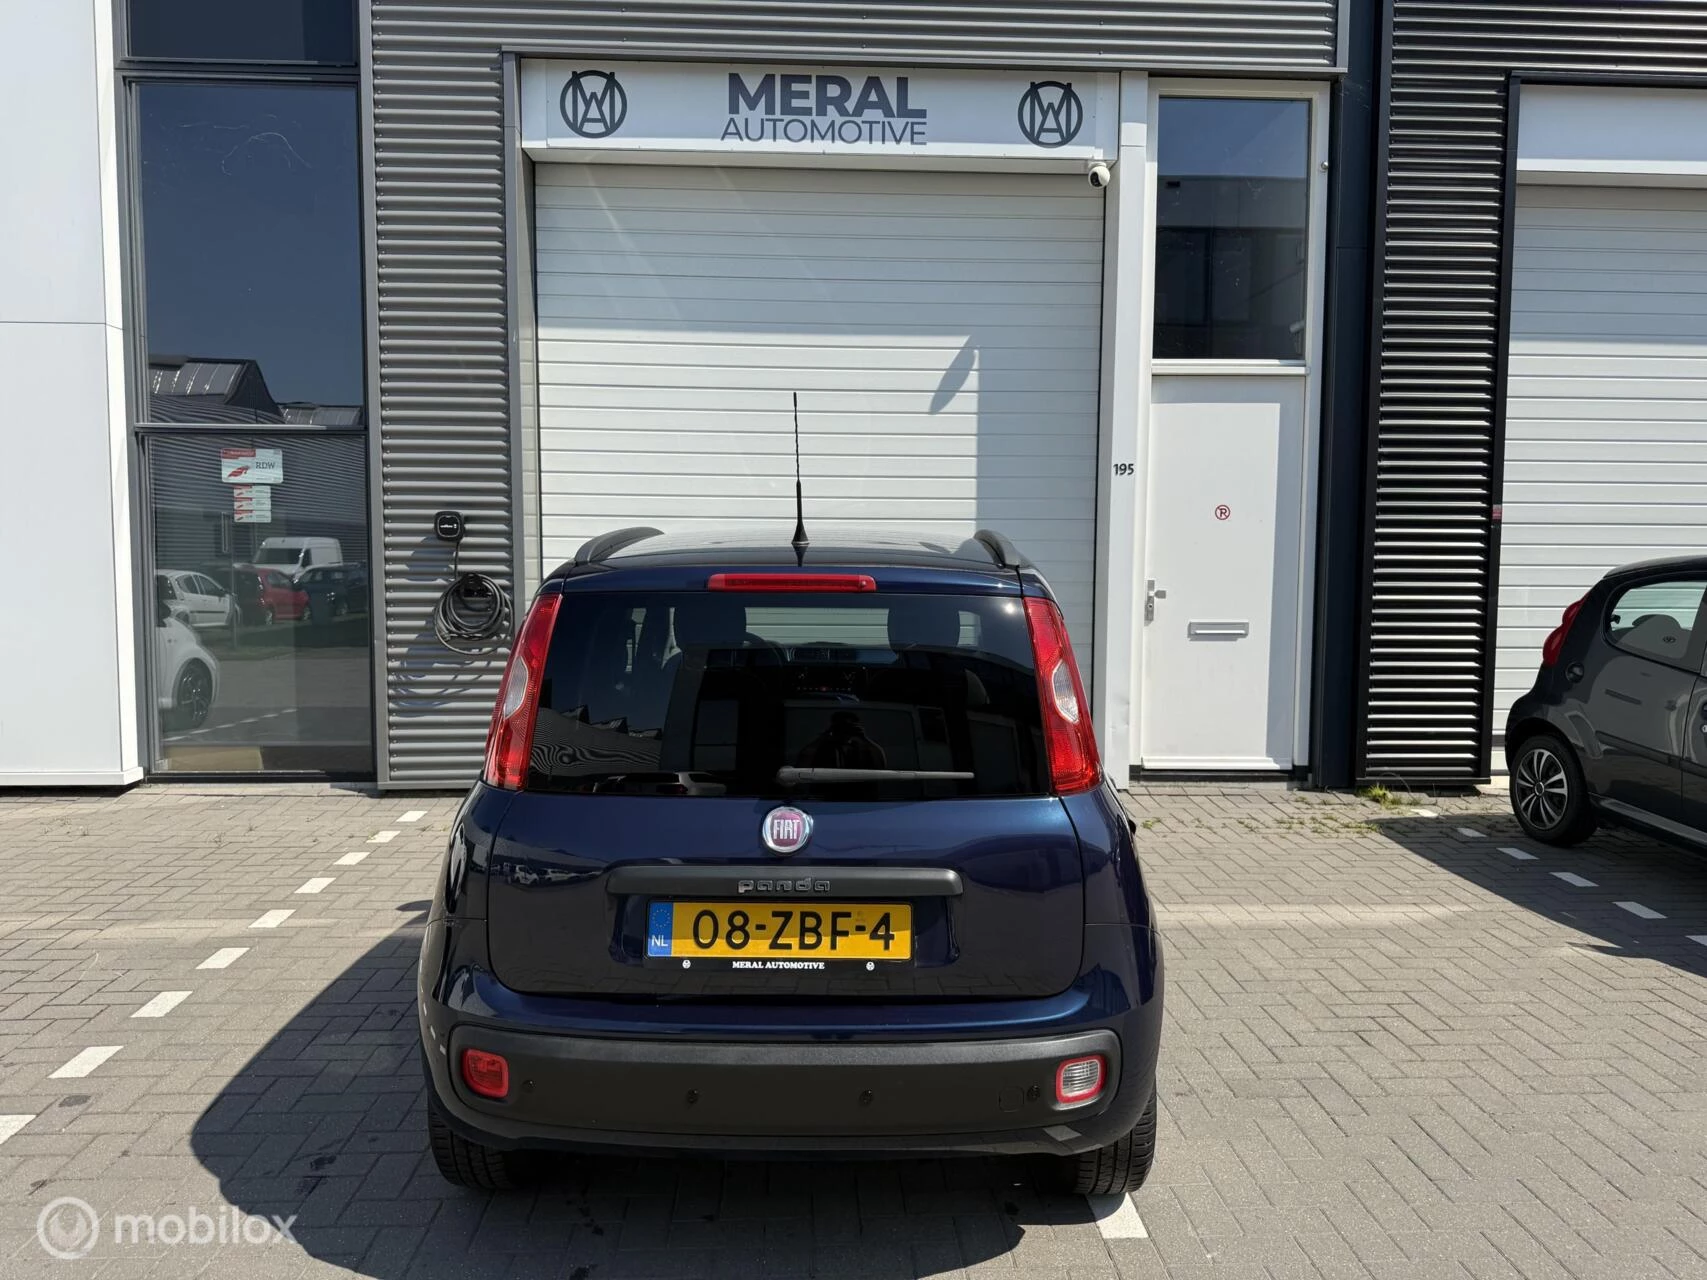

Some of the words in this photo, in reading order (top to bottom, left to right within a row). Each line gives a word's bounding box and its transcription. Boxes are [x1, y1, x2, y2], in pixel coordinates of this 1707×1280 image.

[728, 73, 927, 118] MERAL
[721, 116, 927, 146] AUTOMOTIVE
[255, 461, 275, 470] RDW
[1113, 463, 1135, 476] 195
[773, 818, 800, 840] FIAT
[738, 877, 831, 894] panda
[692, 909, 895, 951] 08-ZBF-4
[651, 934, 669, 948] NL
[732, 961, 763, 969] MERAL
[765, 961, 825, 970] AUTOMOTIVE
